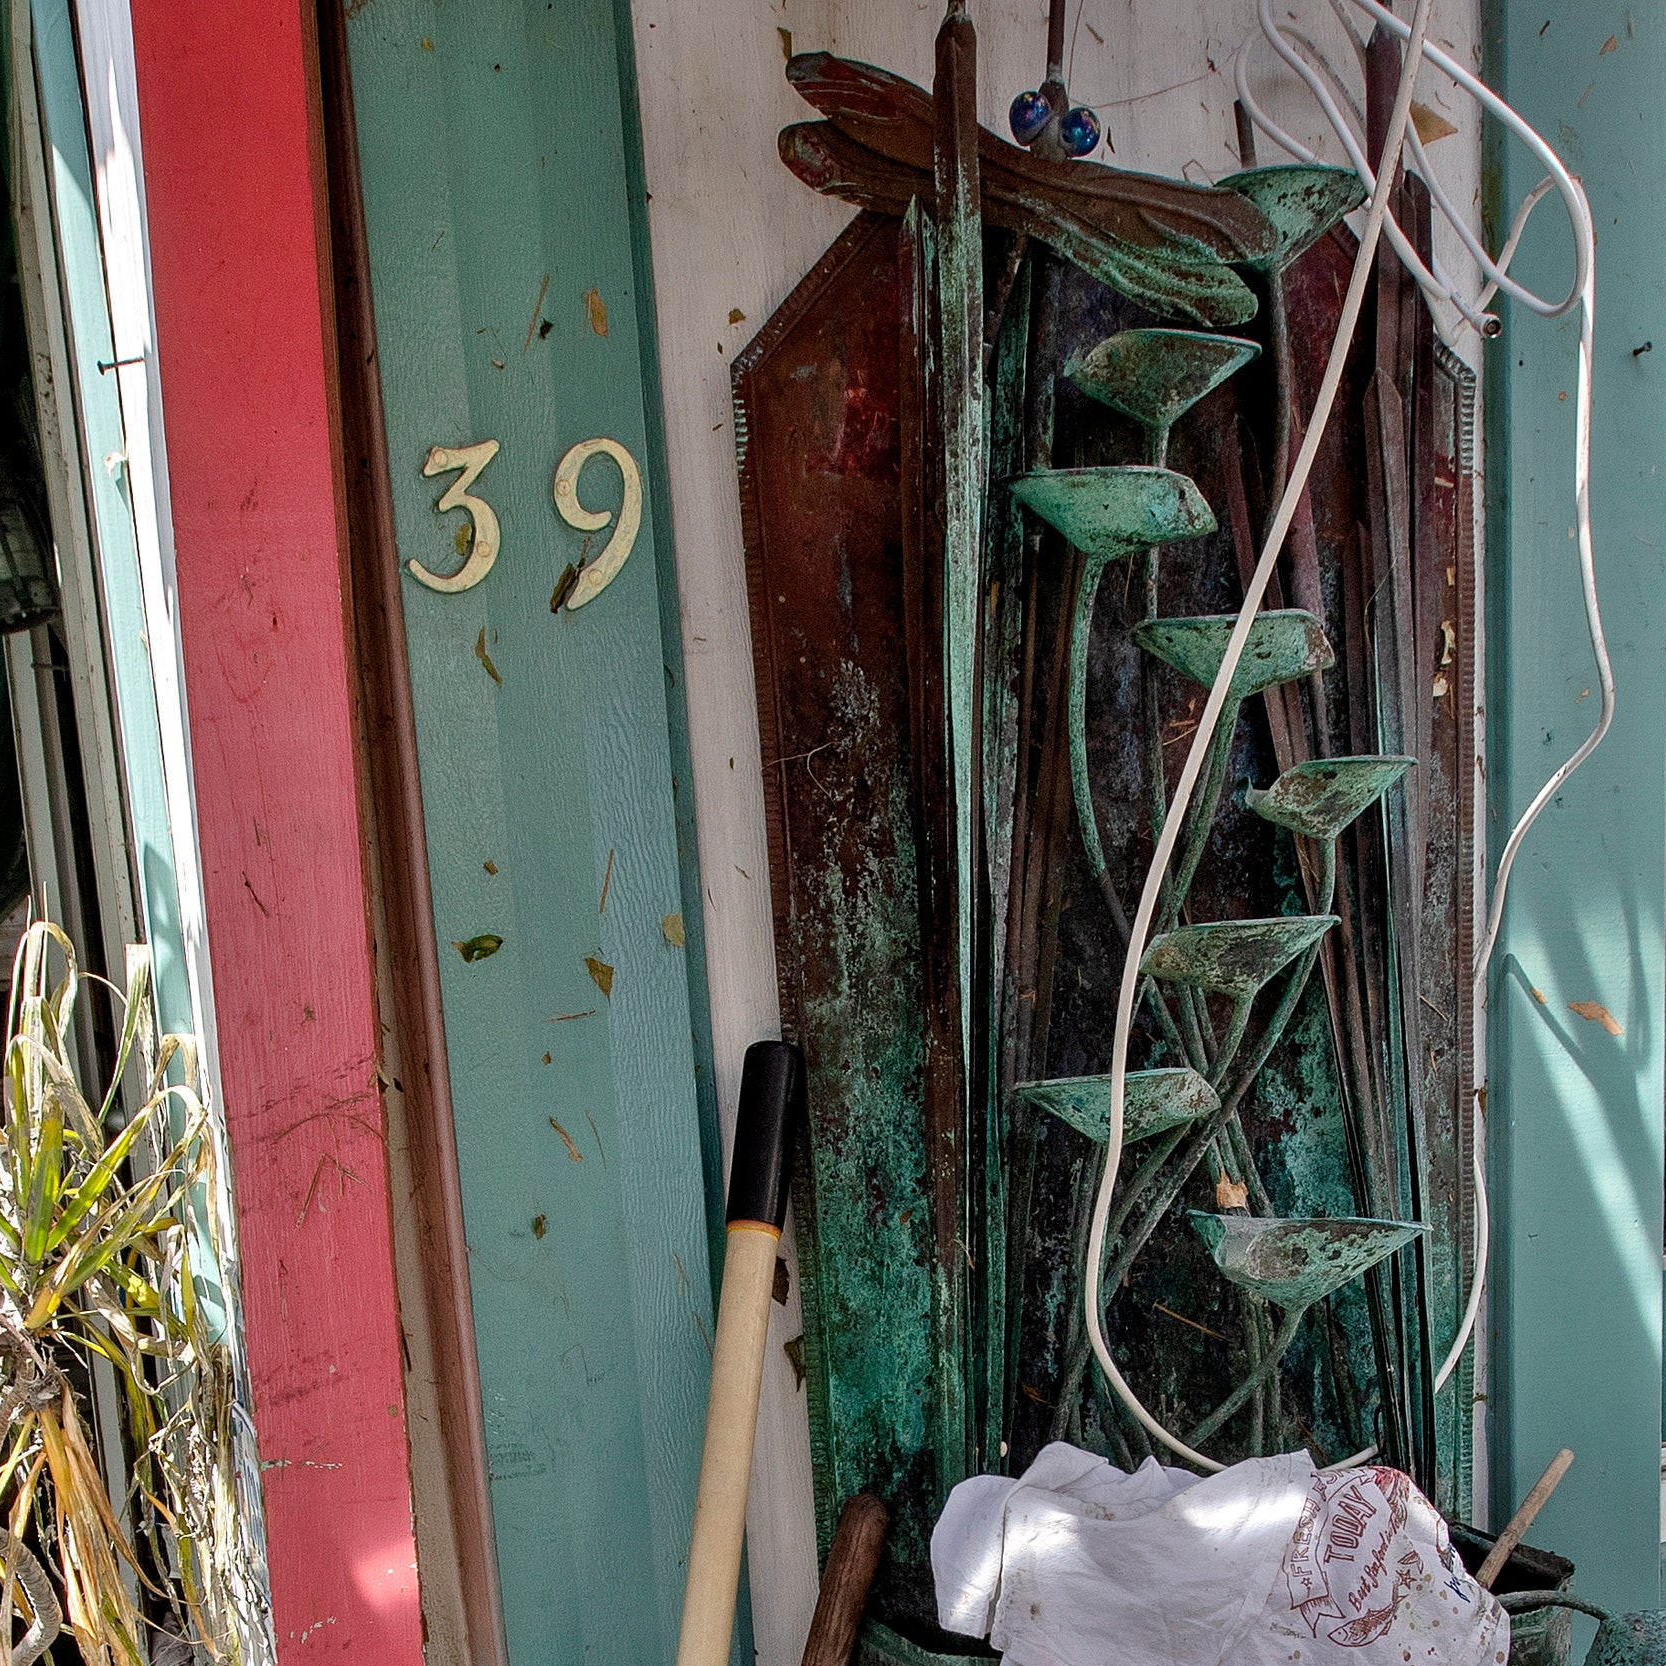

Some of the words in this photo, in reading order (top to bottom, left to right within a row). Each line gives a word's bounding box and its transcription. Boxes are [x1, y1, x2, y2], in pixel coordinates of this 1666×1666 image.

[408, 437, 643, 611] 39
[1289, 1496, 1322, 1579] FRESH
[1323, 1485, 1377, 1566] TODAY
